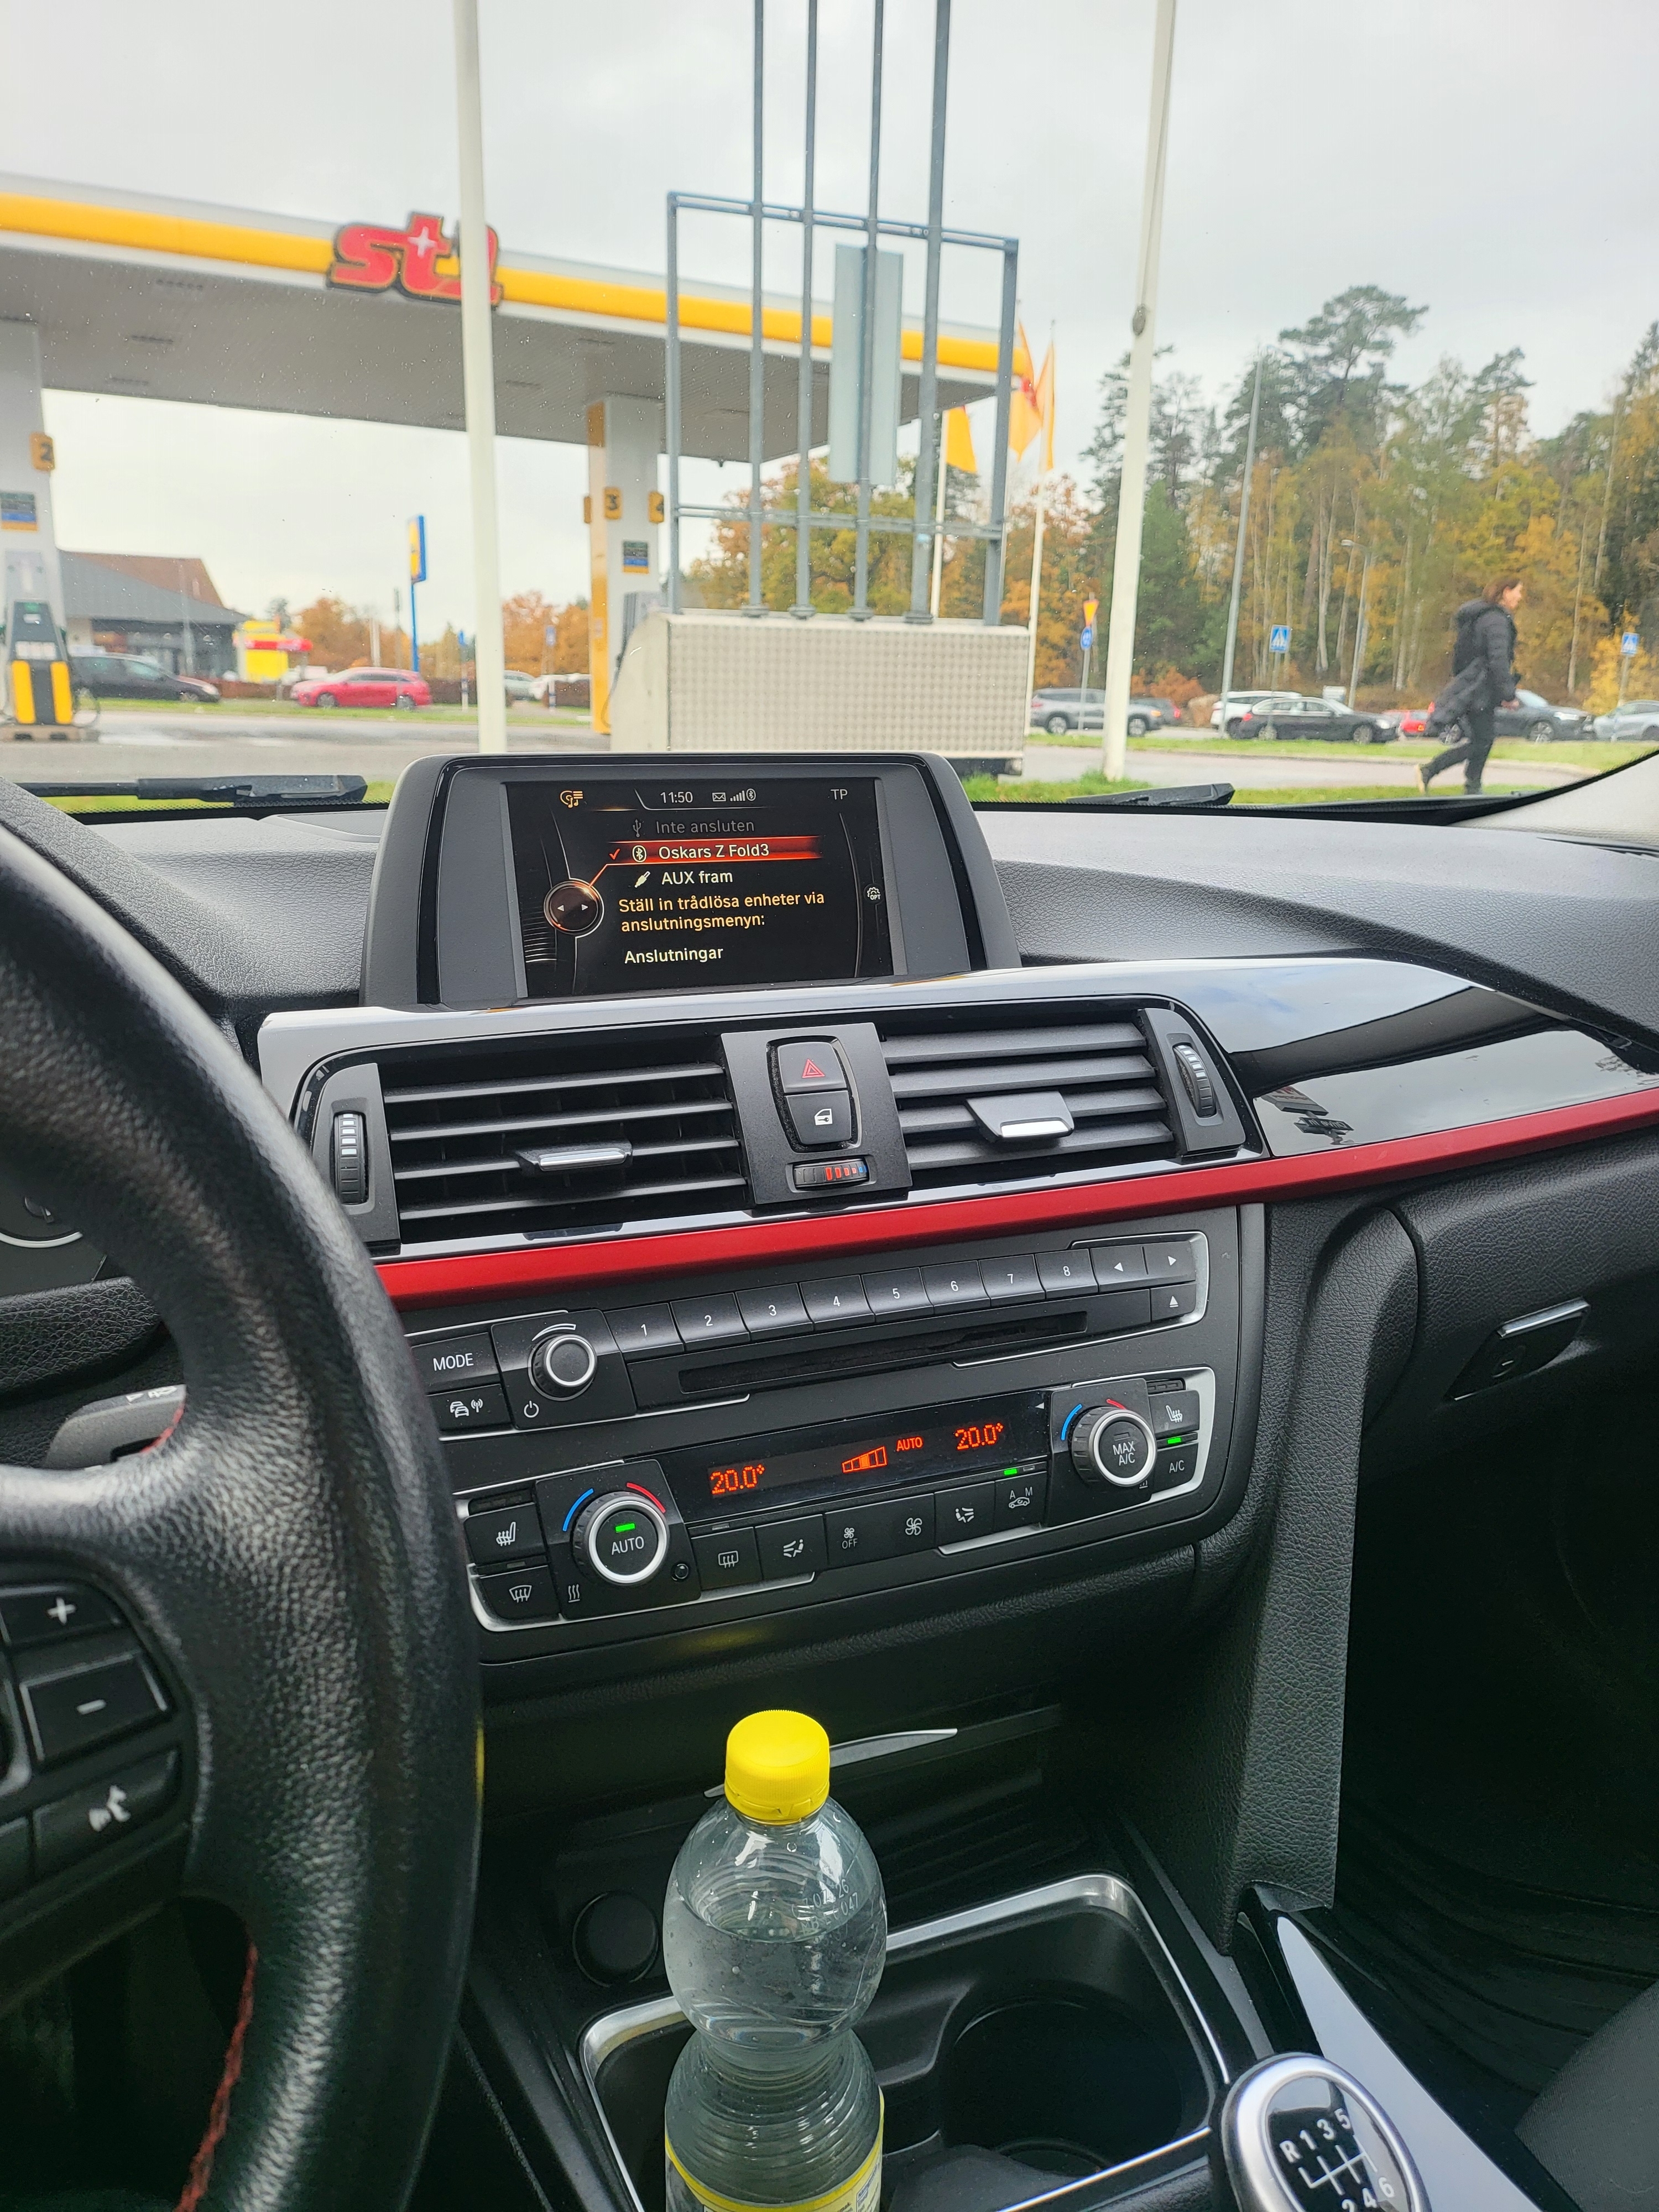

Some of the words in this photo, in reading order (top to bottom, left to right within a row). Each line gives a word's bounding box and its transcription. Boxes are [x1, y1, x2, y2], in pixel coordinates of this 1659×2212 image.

[41, 443, 53, 461] 2
[608, 494, 618, 510] 3
[660, 792, 693, 803] 11:50
[831, 789, 848, 800] TP
[656, 821, 685, 833] Inte
[691, 820, 754, 833] ansluten
[659, 846, 712, 859] Oskars
[715, 845, 725, 857] Z
[729, 843, 769, 857] Fold3
[661, 872, 695, 885] AUX
[698, 871, 733, 884] fram
[618, 898, 654, 912] Ställ
[659, 898, 673, 911] in
[677, 895, 739, 910] trådlösa
[744, 893, 801, 907] enheter
[804, 891, 825, 904] via
[621, 914, 765, 932] anslutningsmenyn:
[624, 947, 723, 964] Anslutningar
[640, 1323, 648, 1337] 1
[704, 1314, 712, 1327] 2
[768, 1305, 776, 1317] 3
[833, 1296, 840, 1308] 4
[892, 1288, 900, 1300] 5
[951, 1280, 958, 1292] 6
[1007, 1273, 1014, 1285] 7
[1063, 1266, 1071, 1277] 8
[433, 1353, 474, 1371] MODE
[896, 1437, 924, 1452] AUTO
[1113, 1441, 1135, 1455] MAX
[1119, 1453, 1135, 1466] A/C
[1169, 1460, 1185, 1473] A/C
[1009, 1490, 1016, 1500] A
[1025, 1486, 1032, 1496] M
[611, 1536, 644, 1555] AUTO
[842, 1538, 858, 1549] OFF
[1279, 2140, 1302, 2163] R
[1300, 2130, 1316, 2150] 1
[1317, 2118, 1335, 2141] 3
[1334, 2107, 1351, 2129] 5
[1362, 2187, 1378, 2208] 4
[1378, 2177, 1395, 2198] 6
